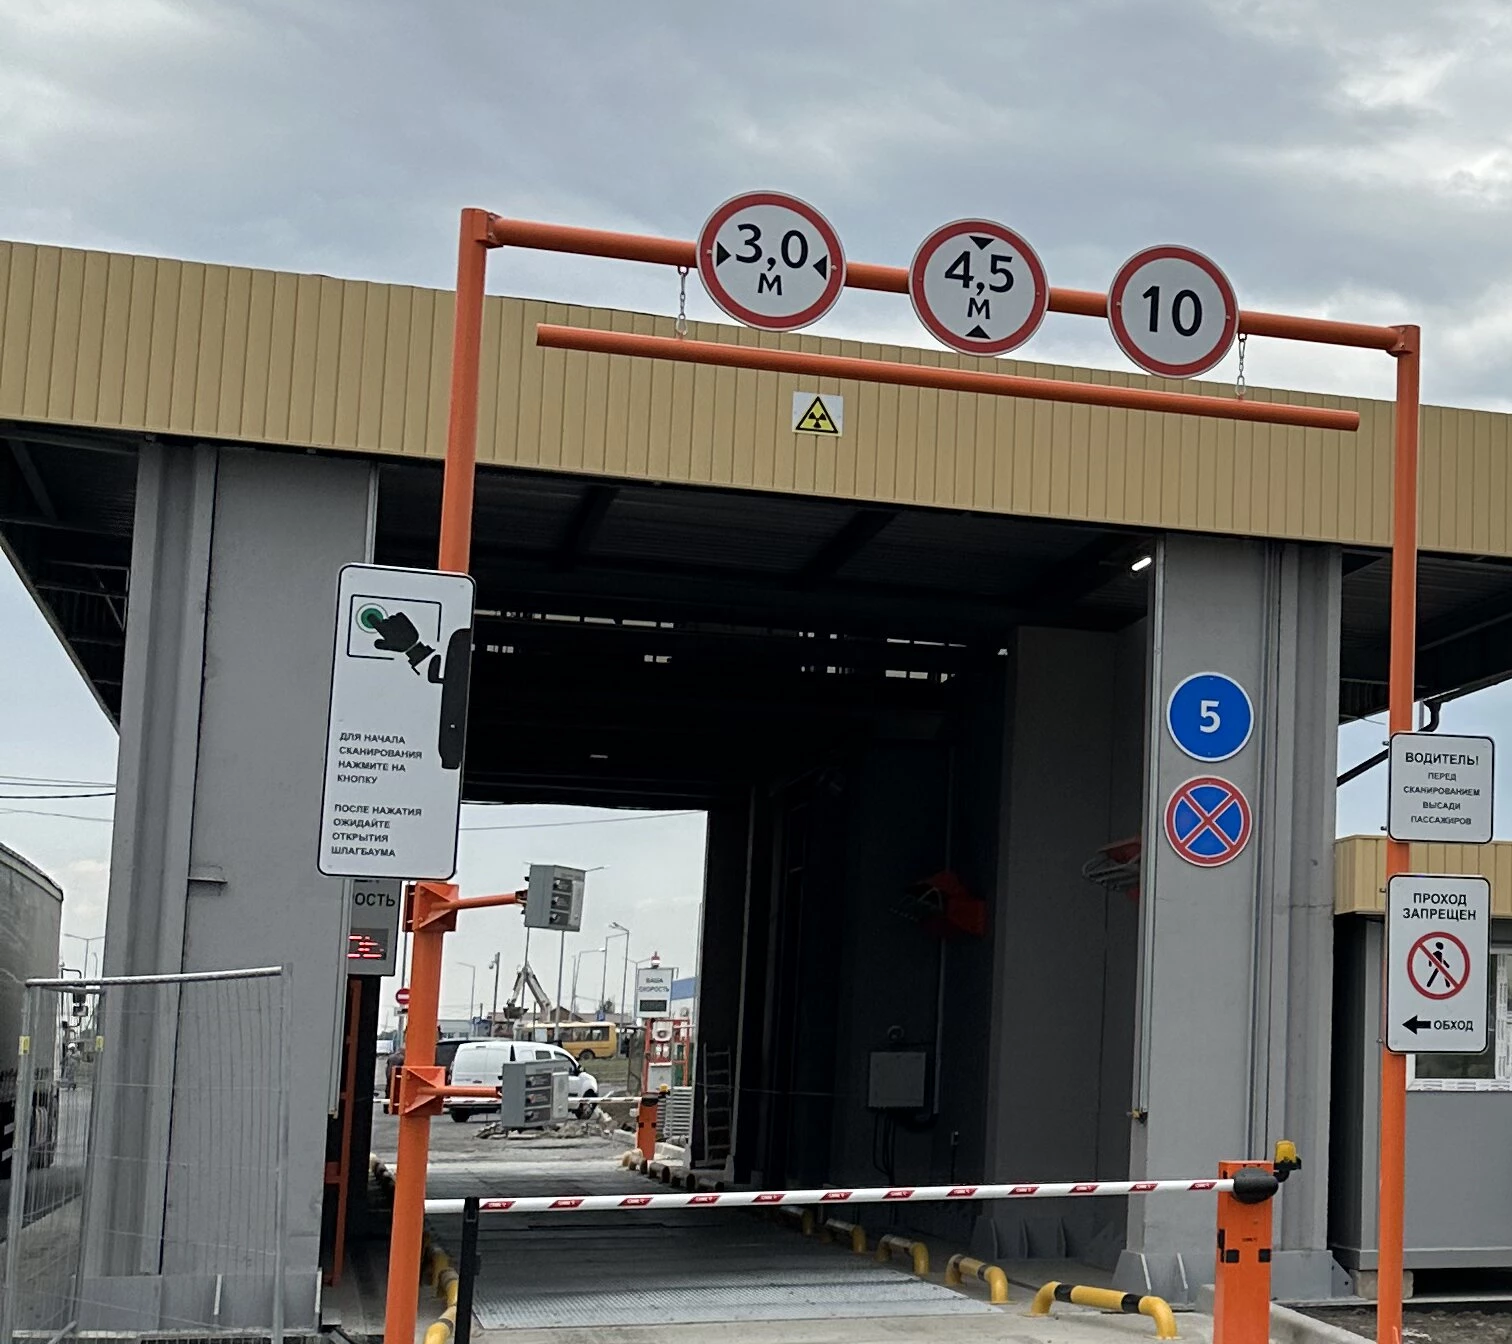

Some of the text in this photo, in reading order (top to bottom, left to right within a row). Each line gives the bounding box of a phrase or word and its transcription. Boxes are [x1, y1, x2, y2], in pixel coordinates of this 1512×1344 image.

[735, 223, 808, 271] 3,0
[944, 251, 1014, 297] 4,5
[1142, 286, 1202, 337] 10
[1199, 700, 1221, 733] 5
[339, 732, 406, 745] ДЛЯ НАЧАЛА
[339, 746, 422, 759] СКАНИРОВАНИЯ
[1405, 752, 1479, 765] ВОДИТЕЛЬ!
[338, 760, 406, 772] НАЖМИТЕ НА
[337, 774, 378, 784] КНОПКУ
[1427, 772, 1456, 781] ПЕРЕД
[1403, 785, 1480, 796] СКАНИРОВАНИЕМ
[334, 804, 422, 816] ПОСЛЕ НАЖАТИЯ
[1422, 801, 1461, 810] ВЫСАДИ
[333, 818, 390, 829] ОЖИДАЙТЕ
[1410, 815, 1472, 825] ПАССАЖИРОВ
[332, 832, 389, 842] ОТКРЫТИЯ
[331, 845, 396, 857] ШЛАГБАУМА
[353, 892, 396, 907] ОСТЬ
[1413, 892, 1467, 906] ПРОХОД
[1402, 907, 1476, 921] ЗАПРЕЩЕН
[1433, 1020, 1474, 1032] ОБХОД
